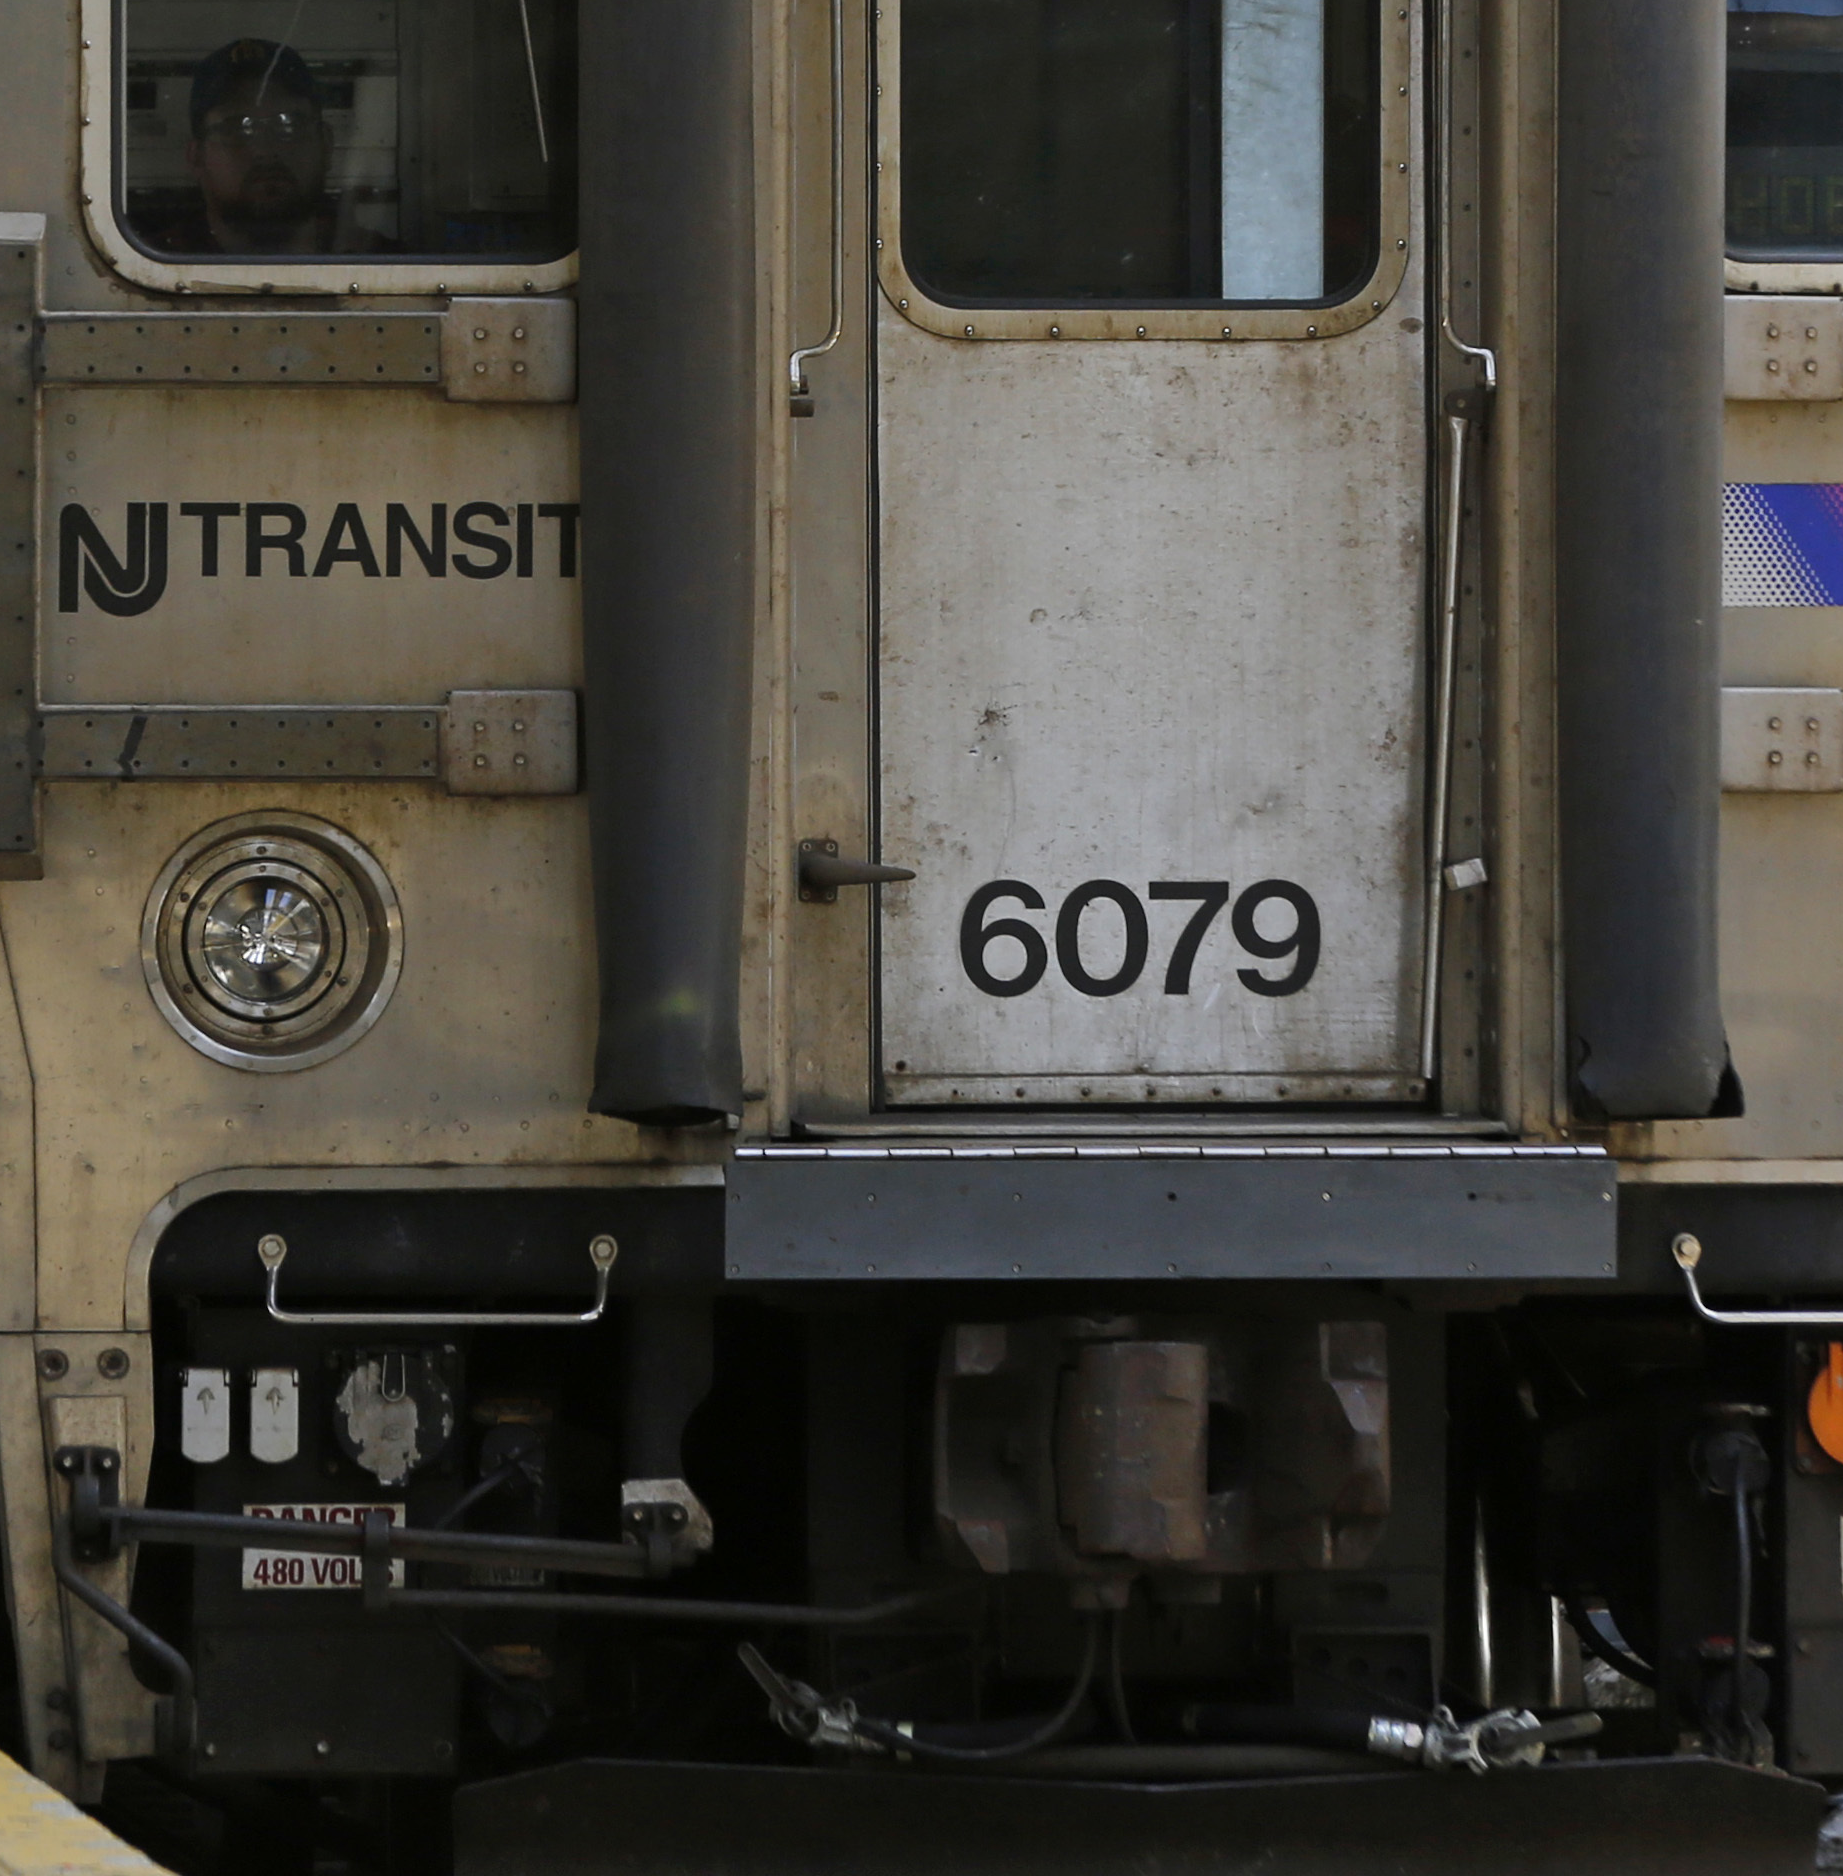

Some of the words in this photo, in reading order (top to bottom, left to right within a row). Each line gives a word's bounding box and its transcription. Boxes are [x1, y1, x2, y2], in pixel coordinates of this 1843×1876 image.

[59, 502, 168, 617] NJ
[180, 501, 581, 580] TRANSIT
[959, 878, 1322, 998] 6079
[253, 1558, 304, 1585] 480
[311, 1557, 394, 1586] VOL
